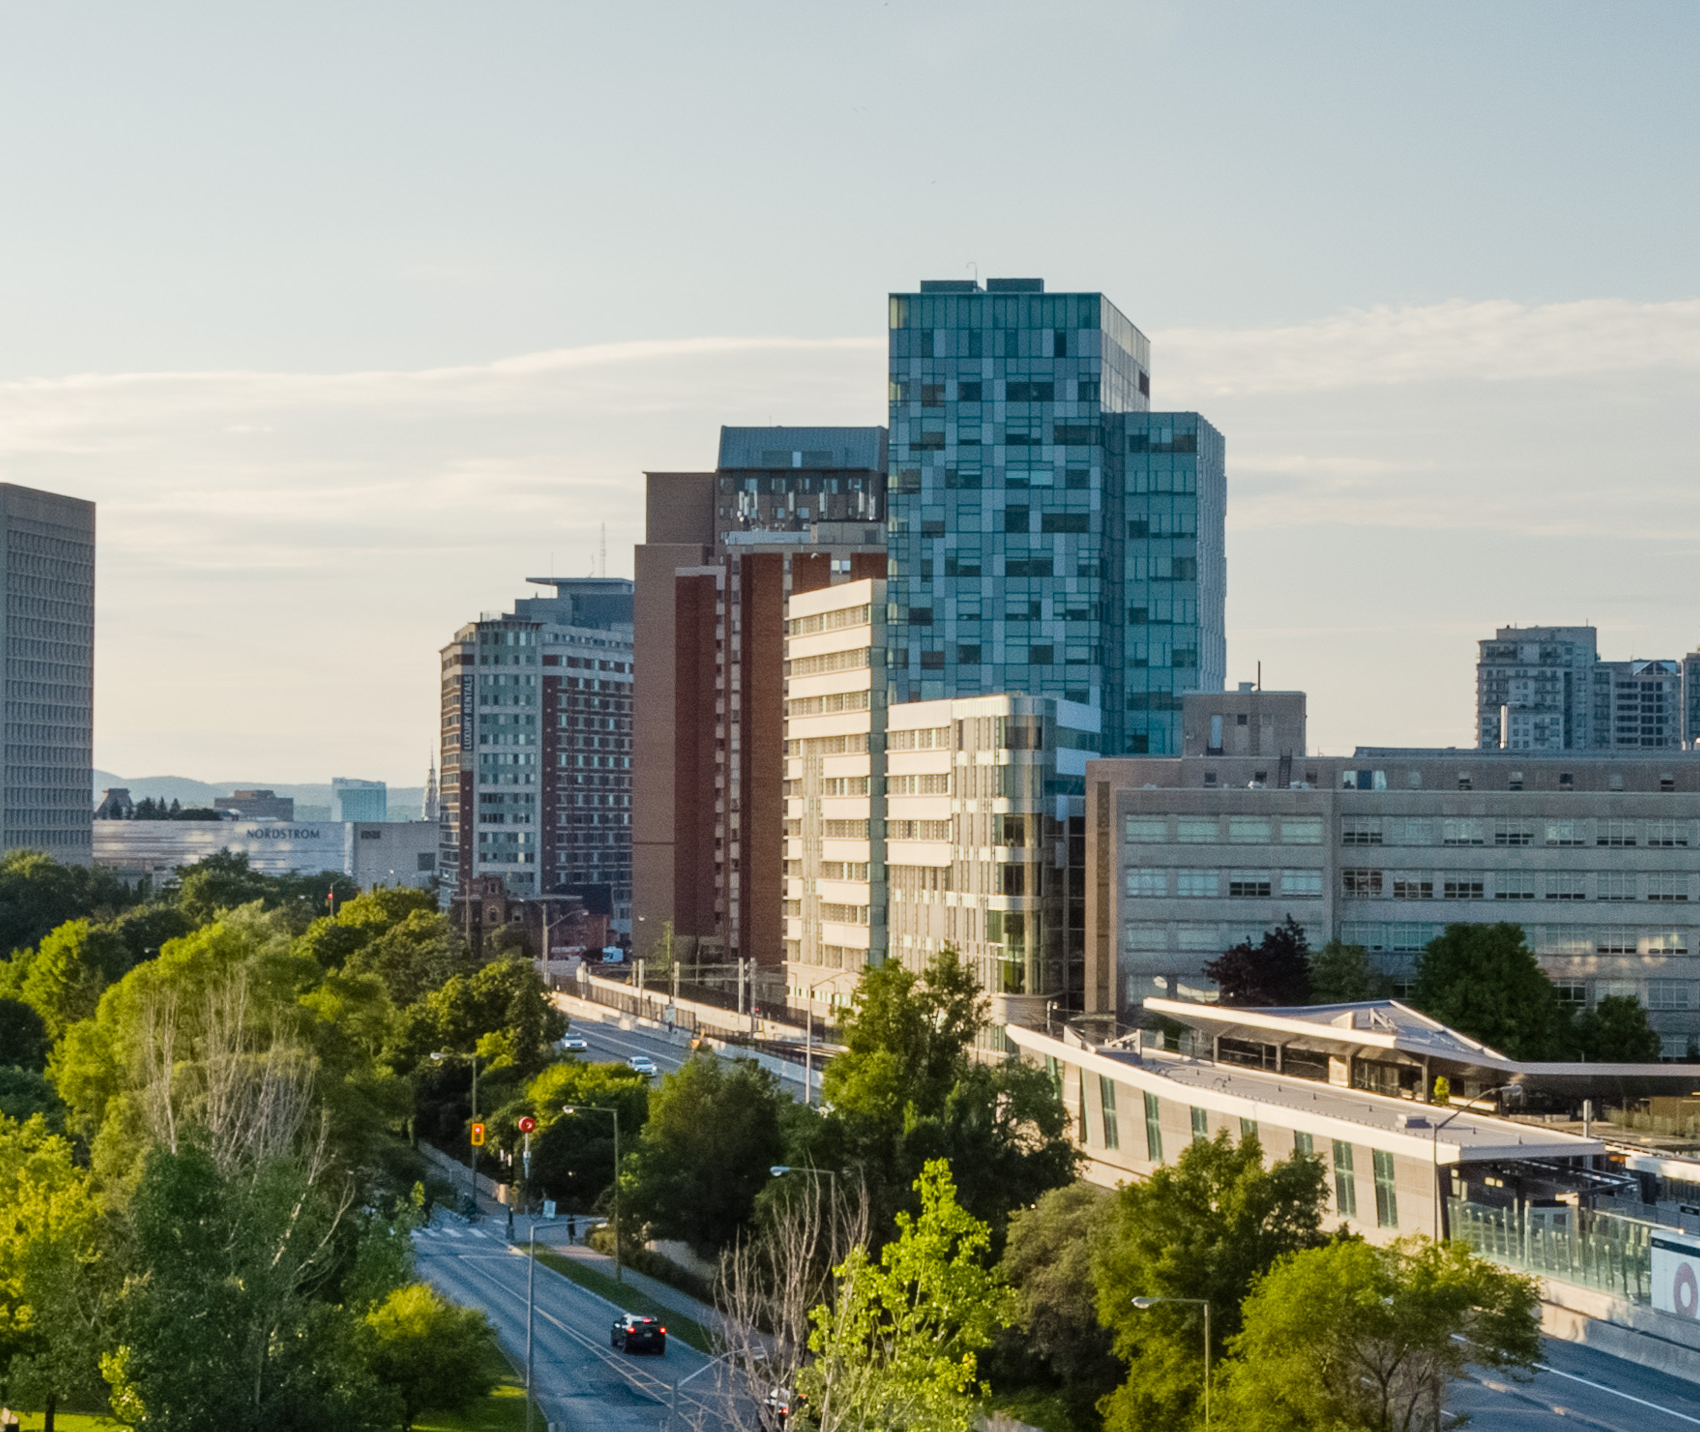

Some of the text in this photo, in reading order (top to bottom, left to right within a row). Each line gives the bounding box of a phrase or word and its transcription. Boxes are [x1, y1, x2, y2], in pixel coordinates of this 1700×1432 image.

[463, 675, 473, 750] LUXURY RENTALS
[246, 828, 320, 839] NORDSTROM
